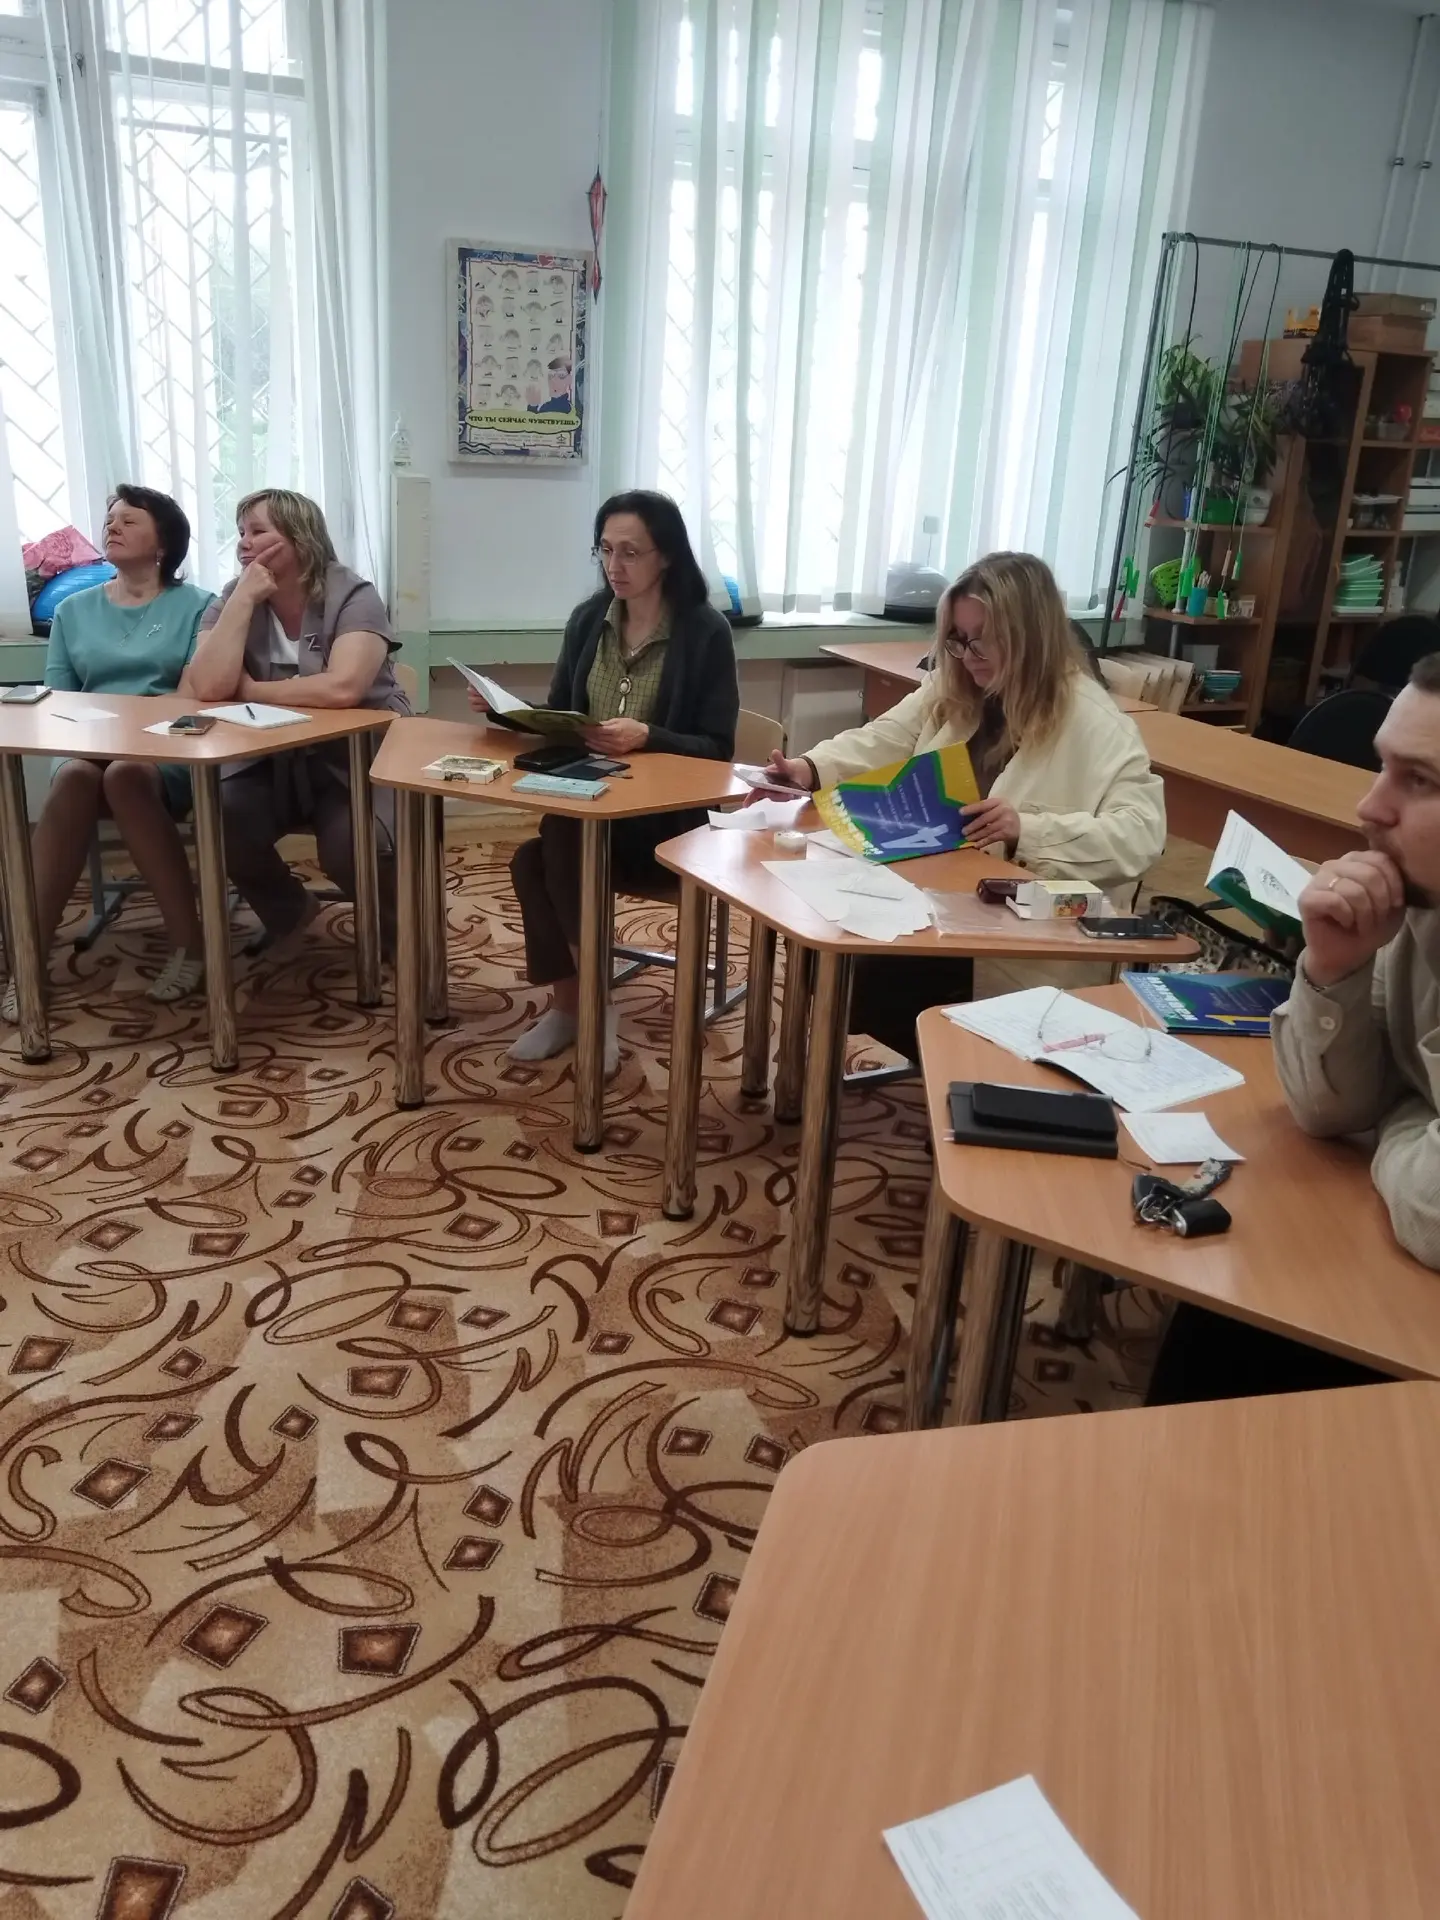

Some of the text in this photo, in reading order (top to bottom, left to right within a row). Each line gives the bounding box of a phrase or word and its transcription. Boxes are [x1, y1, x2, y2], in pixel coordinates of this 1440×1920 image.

[528, 418, 579, 426] ЧУВСТВУЕШЬ?
[880, 823, 949, 849] 4
[1204, 1014, 1272, 1026] 1
